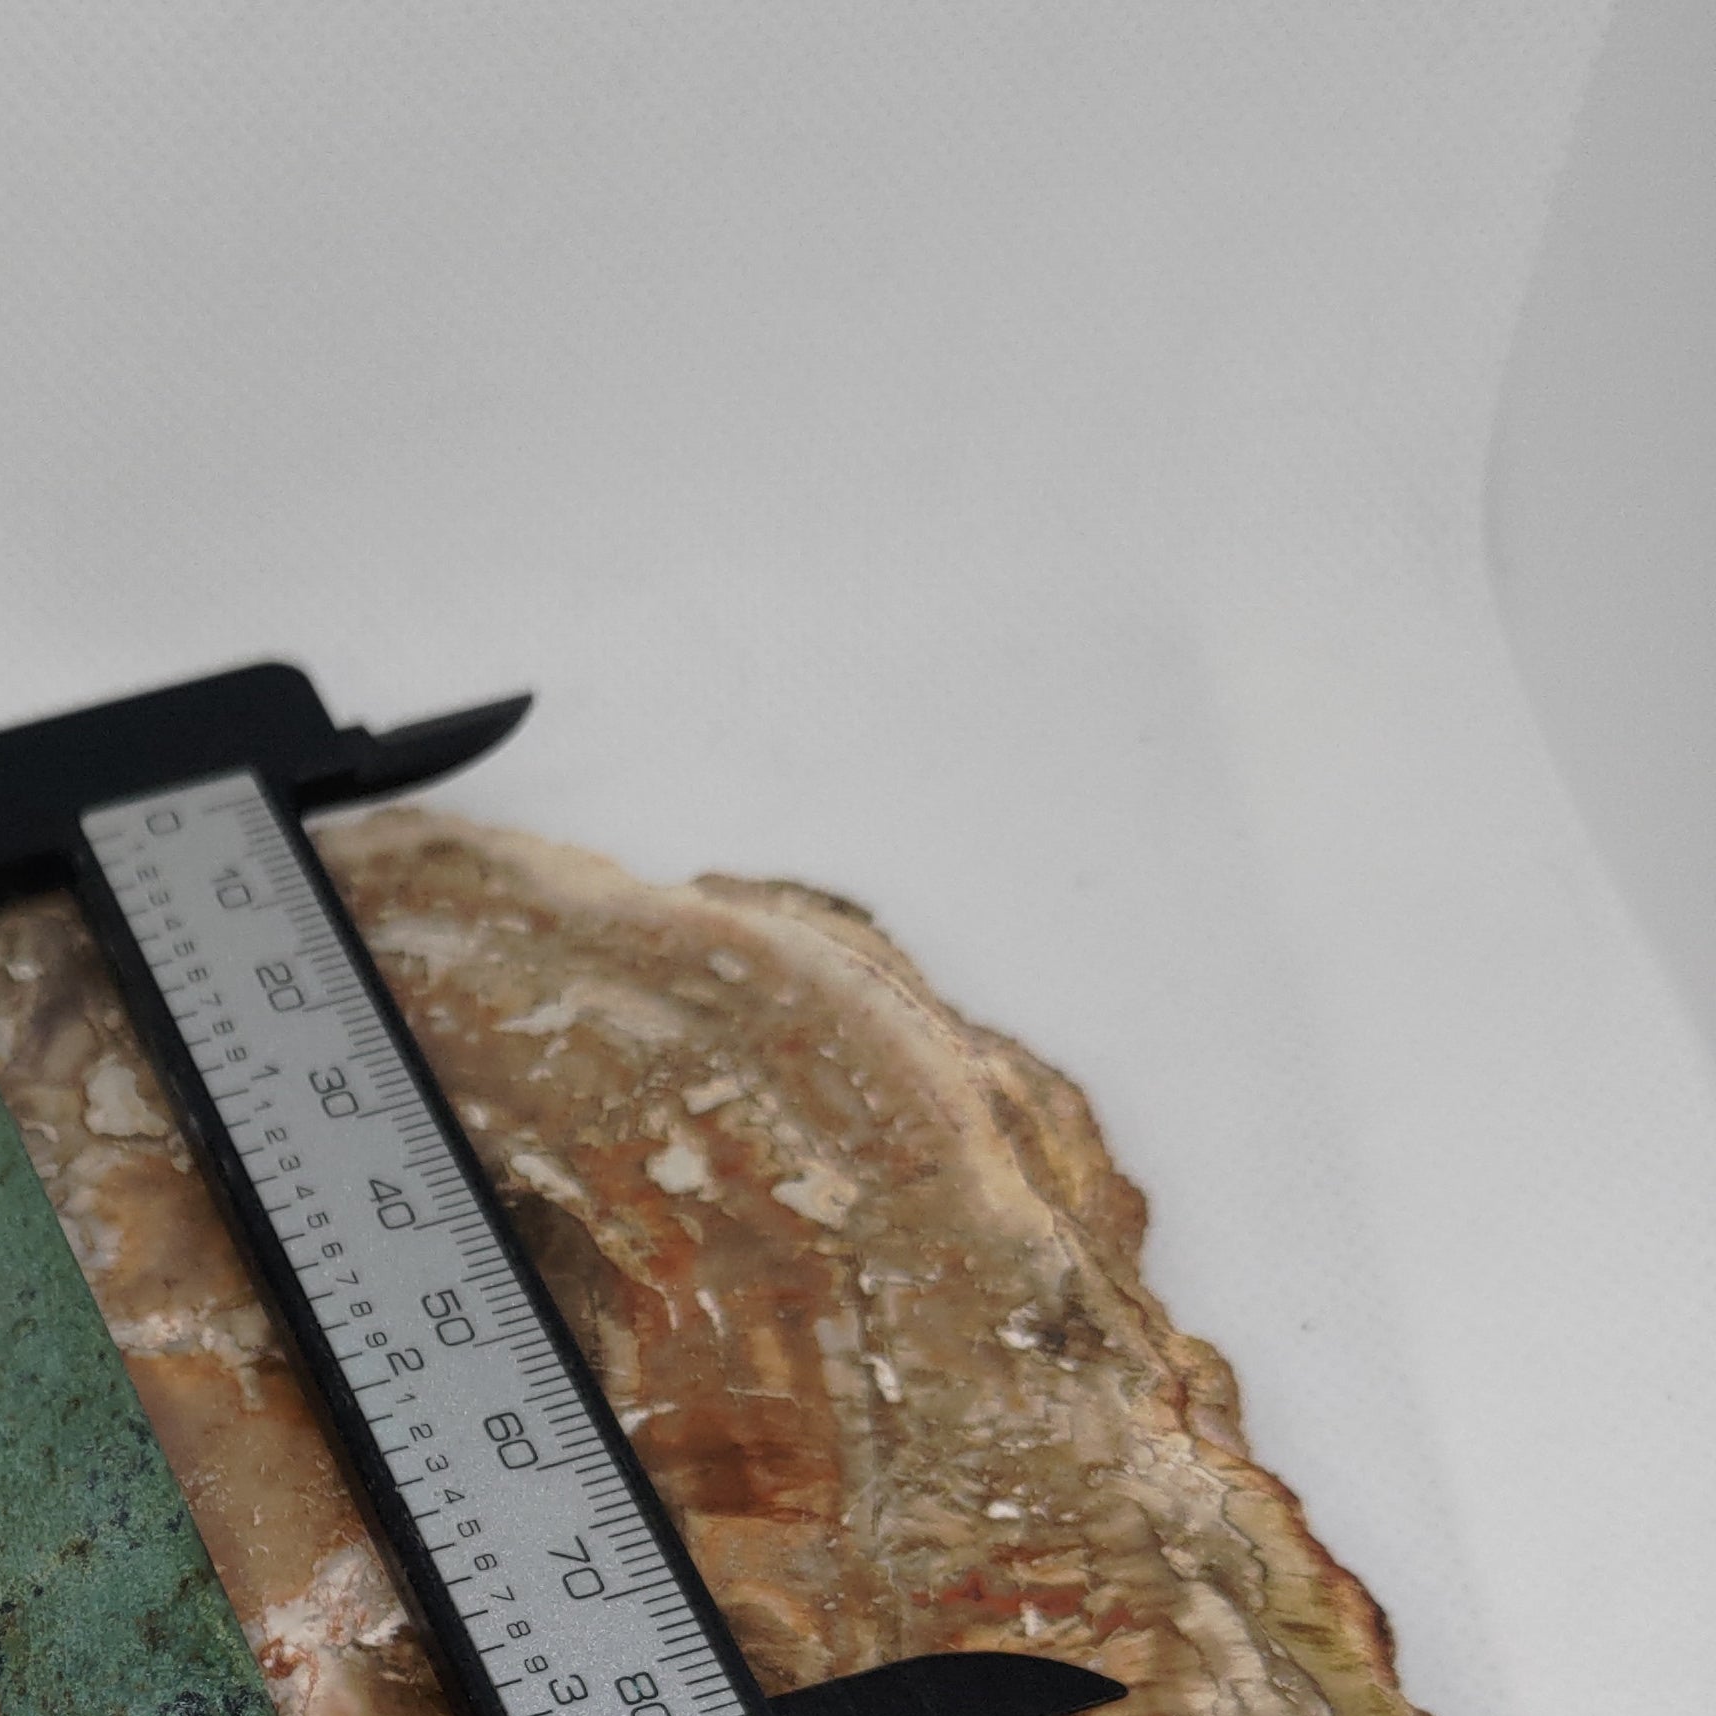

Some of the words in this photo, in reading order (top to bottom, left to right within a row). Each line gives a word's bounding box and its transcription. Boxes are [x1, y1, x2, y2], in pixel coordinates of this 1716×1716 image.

[165, 918, 182, 931] 4
[200, 992, 222, 1006] 7
[212, 1020, 234, 1035] 8
[225, 1047, 247, 1062] 9
[250, 1065, 280, 1081] 1
[254, 1101, 273, 1112] 1
[264, 1127, 287, 1144] 2
[279, 1155, 301, 1171] 3
[296, 1185, 315, 1199] 4
[146, 811, 181, 836] 0
[211, 867, 253, 909] 10
[256, 962, 305, 1012] 20
[309, 1066, 359, 1118] 30
[368, 1179, 416, 1230] 40
[421, 1289, 476, 1347] 50
[484, 1411, 539, 1471] 60
[547, 1535, 605, 1600] 70
[306, 1211, 329, 1229] 5
[321, 1242, 344, 1258] 6
[336, 1269, 359, 1285] 7
[350, 1301, 373, 1318] 8
[365, 1331, 388, 1348] 9
[386, 1348, 424, 1376] 2
[396, 1393, 416, 1404] 1
[409, 1423, 434, 1442] 2
[425, 1455, 449, 1472] 3
[444, 1488, 466, 1504] 4
[457, 1519, 481, 1538] 5
[474, 1553, 497, 1571] 6
[491, 1586, 515, 1602] 7
[506, 1620, 531, 1639] 8
[524, 1655, 549, 1674] 9
[548, 1674, 589, 1705] 3
